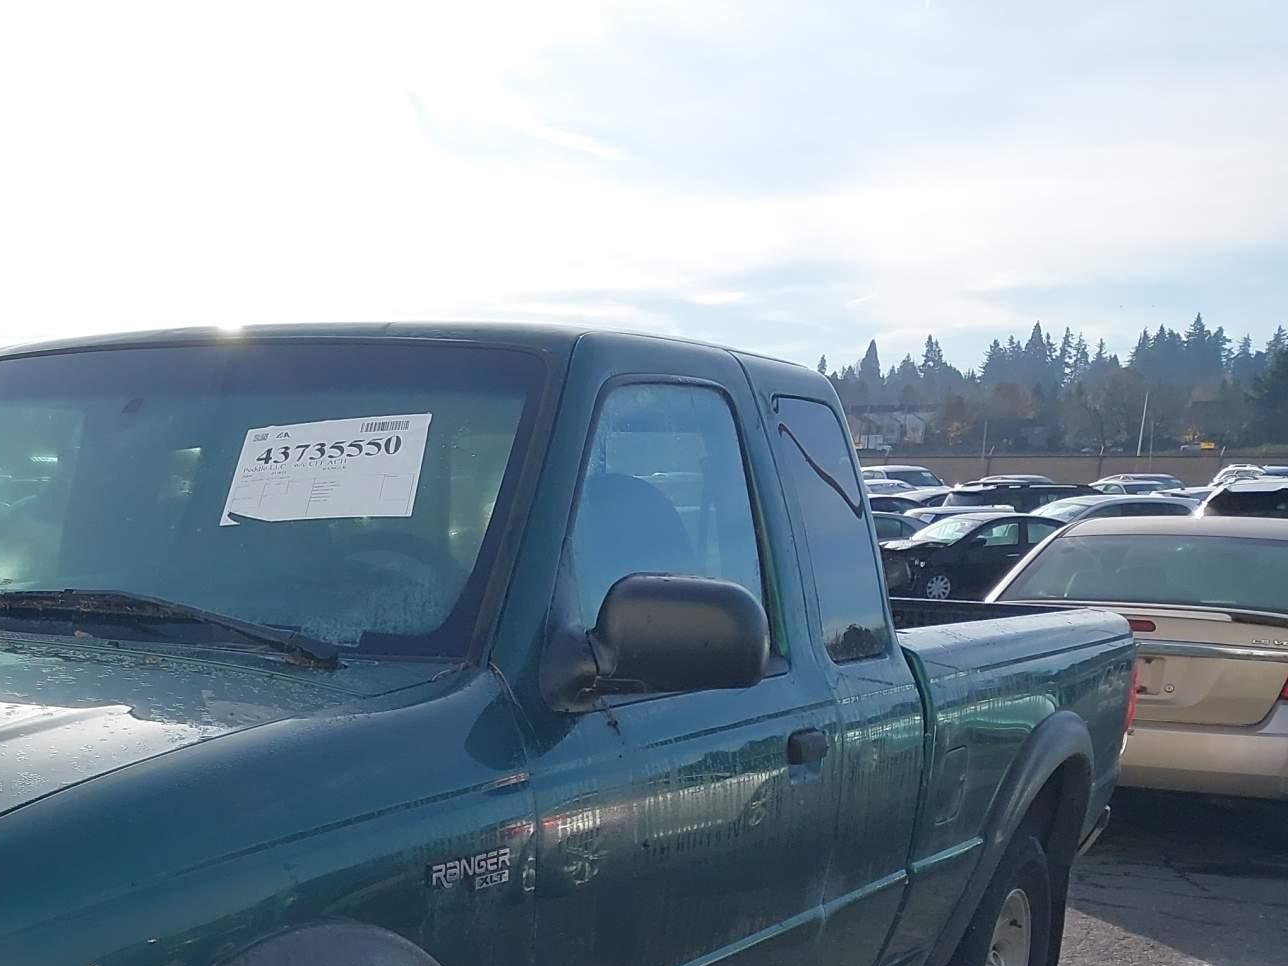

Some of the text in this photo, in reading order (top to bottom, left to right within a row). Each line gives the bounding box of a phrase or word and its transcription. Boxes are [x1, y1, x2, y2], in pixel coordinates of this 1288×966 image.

[255, 435, 402, 465] 43735550
[432, 848, 511, 889] RANGER
[478, 871, 508, 888] XLT
